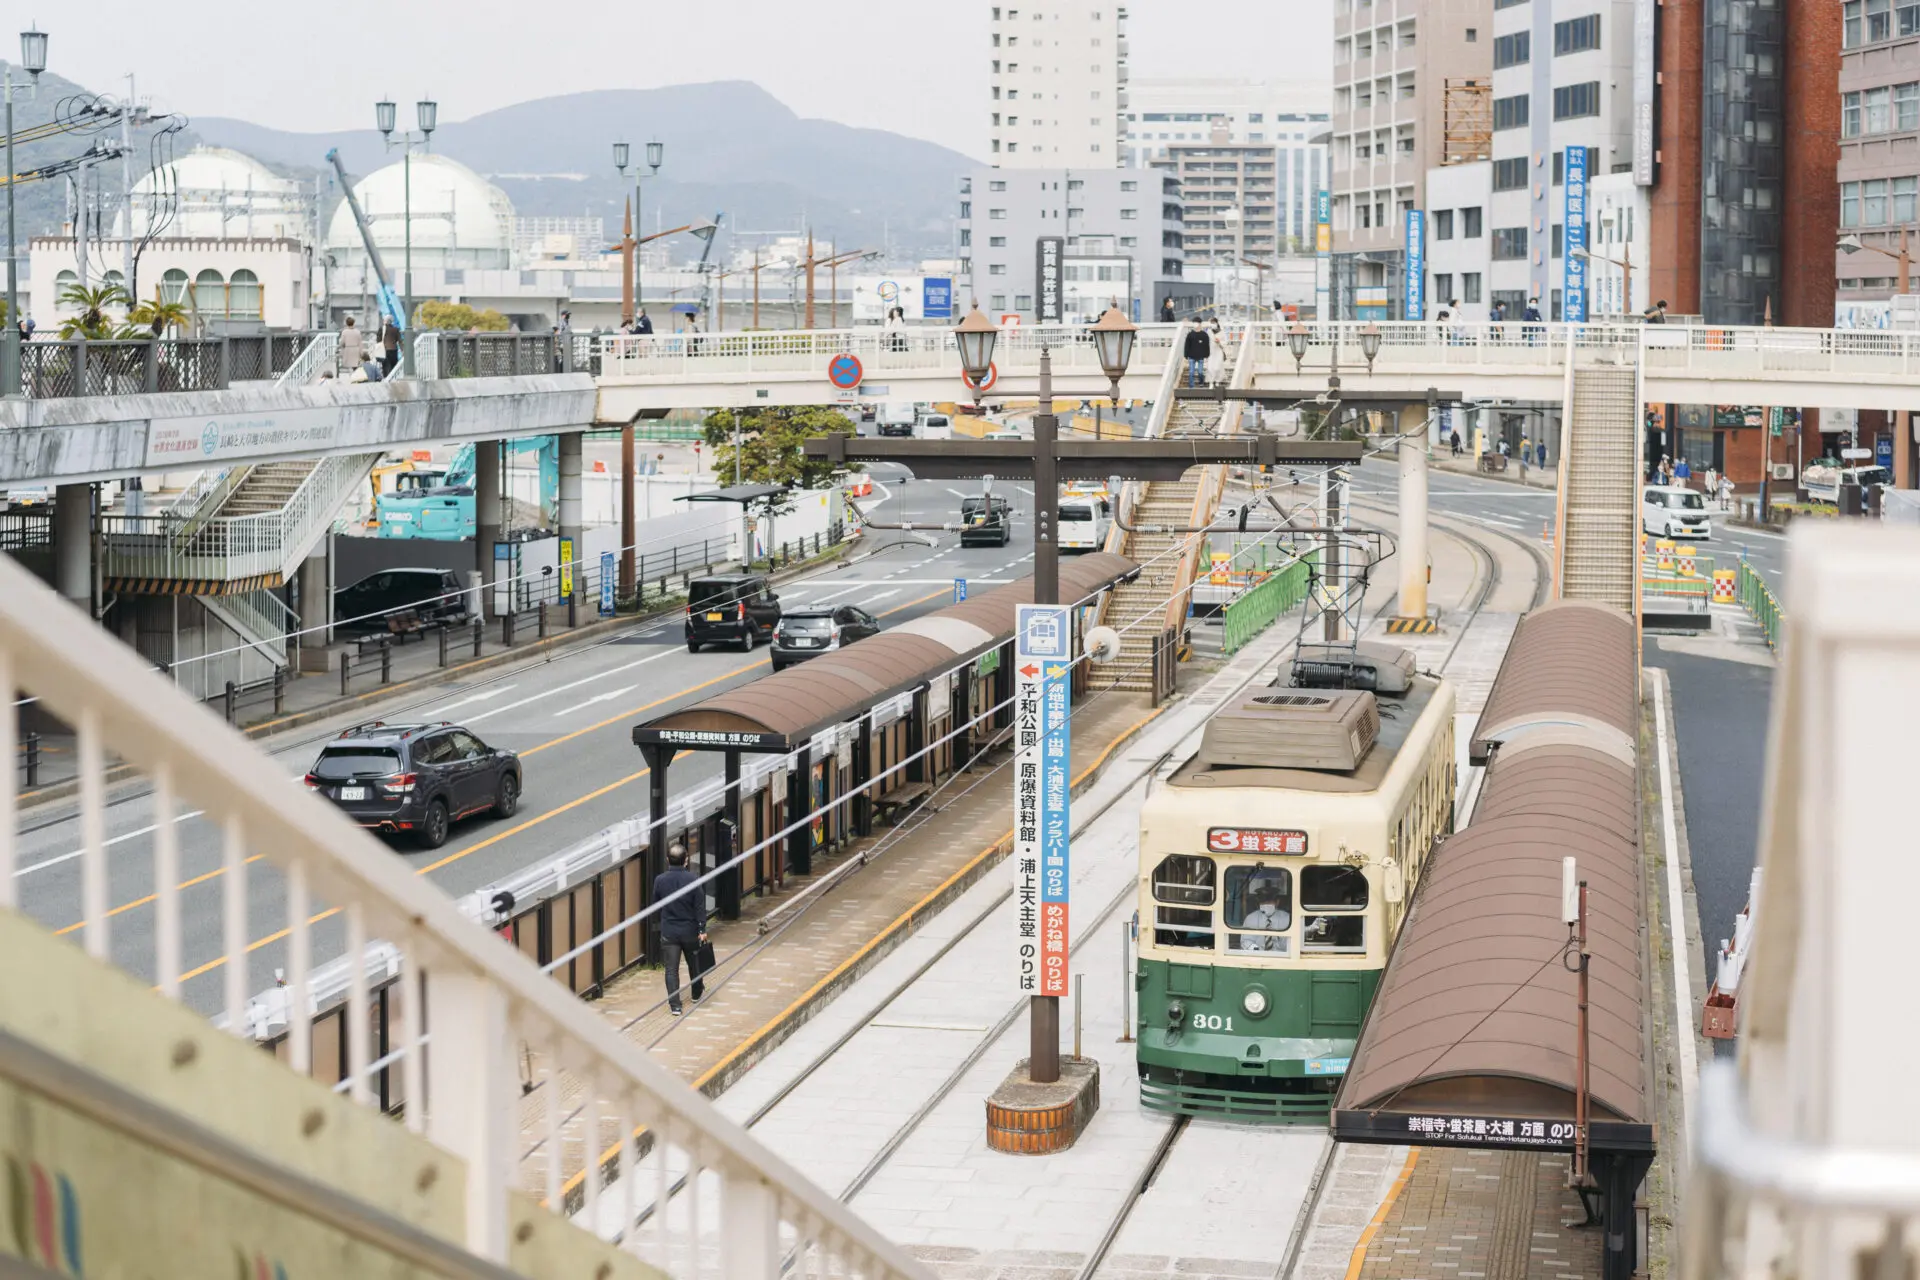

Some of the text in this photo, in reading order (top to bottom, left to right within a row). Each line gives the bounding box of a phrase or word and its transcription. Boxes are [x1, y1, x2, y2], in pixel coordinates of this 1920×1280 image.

[743, 734, 760, 743] のりば
[1210, 829, 1239, 849] 3
[1047, 869, 1064, 896] のりば
[1046, 906, 1064, 991] めがね橋 のりば
[1020, 944, 1035, 990] のりば
[1520, 1122, 1545, 1137] 方面
